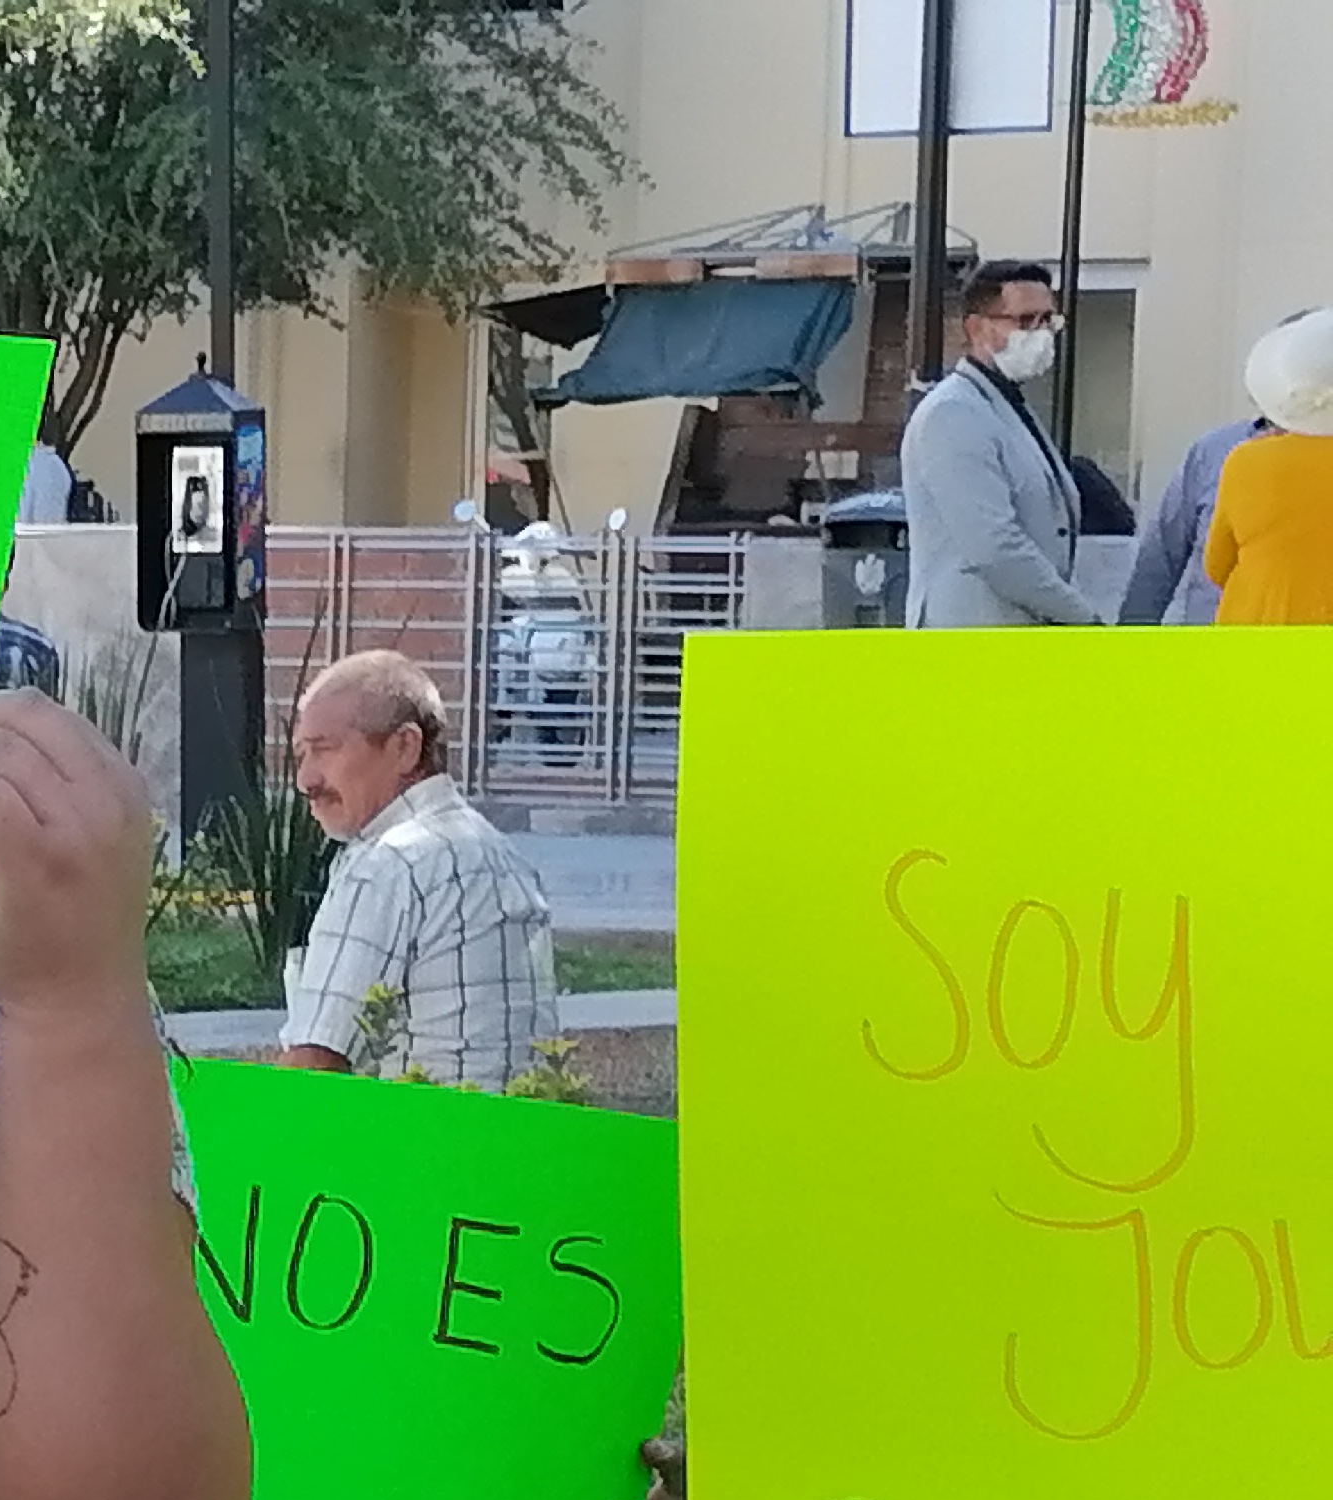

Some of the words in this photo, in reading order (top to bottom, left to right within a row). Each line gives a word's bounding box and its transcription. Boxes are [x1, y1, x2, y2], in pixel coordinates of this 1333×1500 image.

[862, 848, 1195, 1192] Soy
[195, 1184, 376, 1331] NO
[434, 1216, 623, 1367] ES
